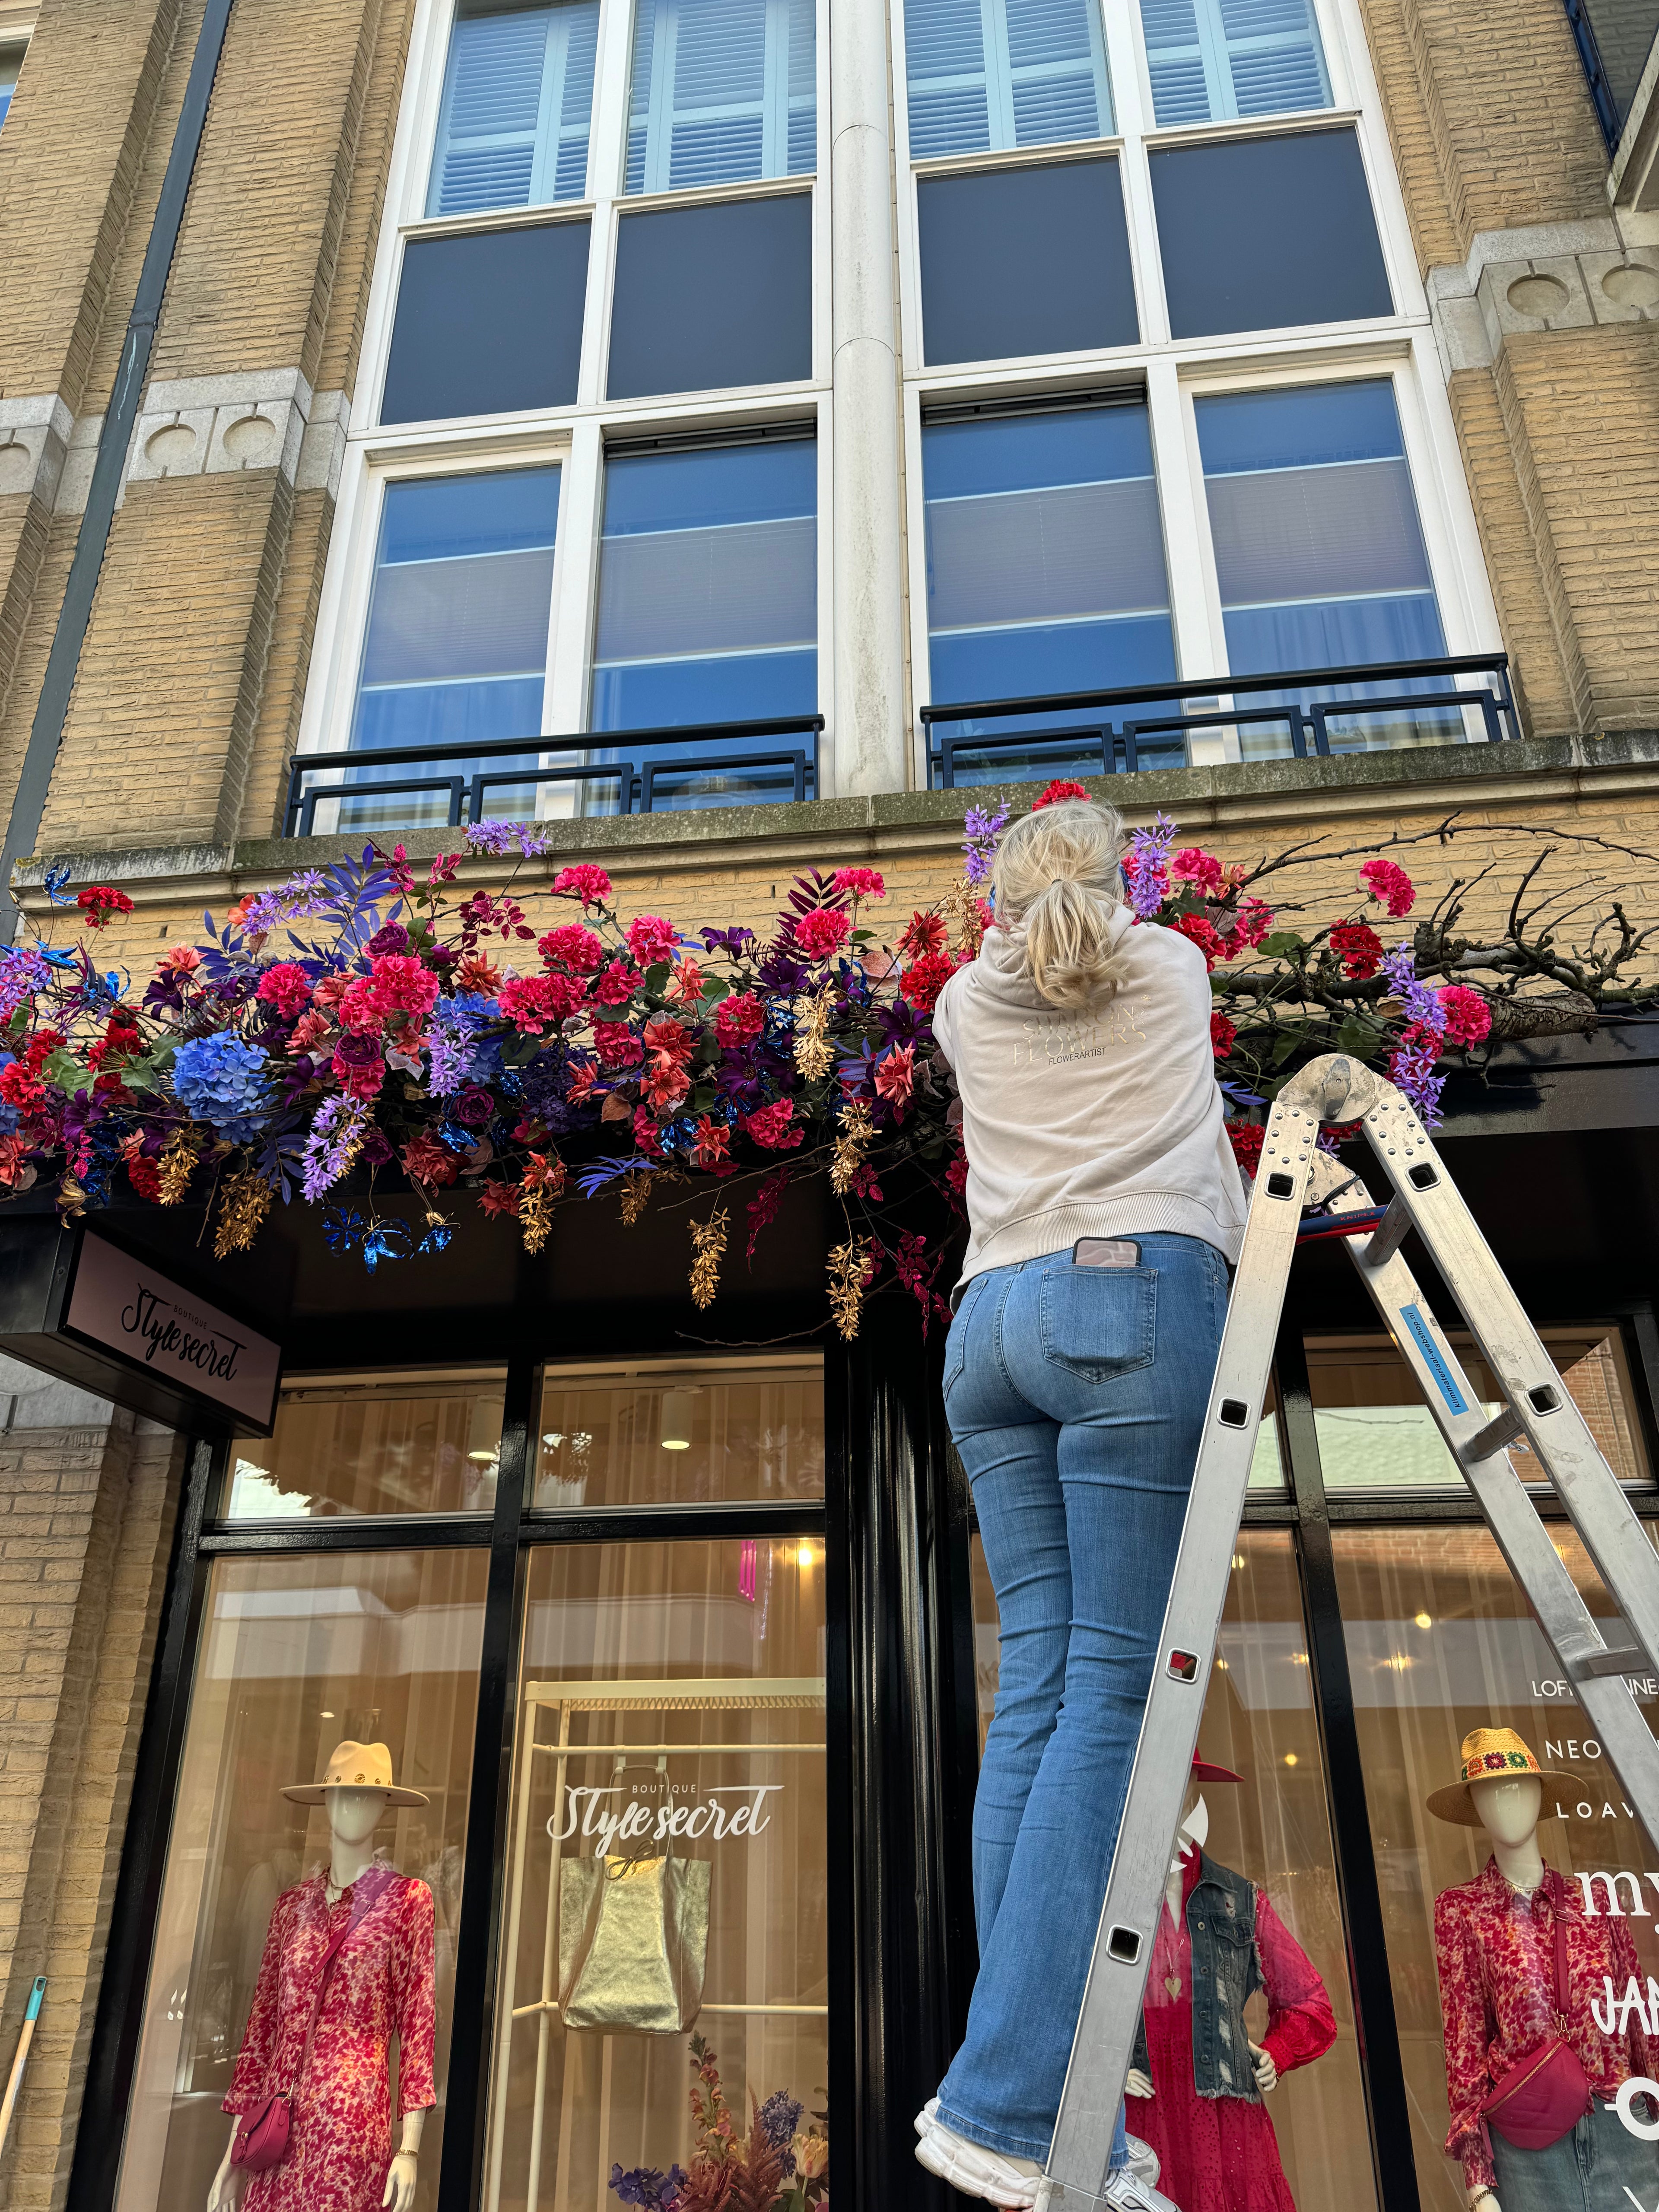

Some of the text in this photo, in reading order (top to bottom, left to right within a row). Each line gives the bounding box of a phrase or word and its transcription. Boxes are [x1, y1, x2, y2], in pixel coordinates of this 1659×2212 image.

[1014, 1022, 1147, 1065] FLOWERS
[1049, 1047, 1106, 1065] FLOWERARTIST
[174, 1304, 208, 1329] BOUTIQUE
[1407, 1312, 1461, 1408] klimmateriaal-webshop.nl
[1545, 1739, 1602, 1759] NEO
[632, 1784, 696, 1793] BOUTIQUE
[1556, 1802, 1634, 1818] LOAV
